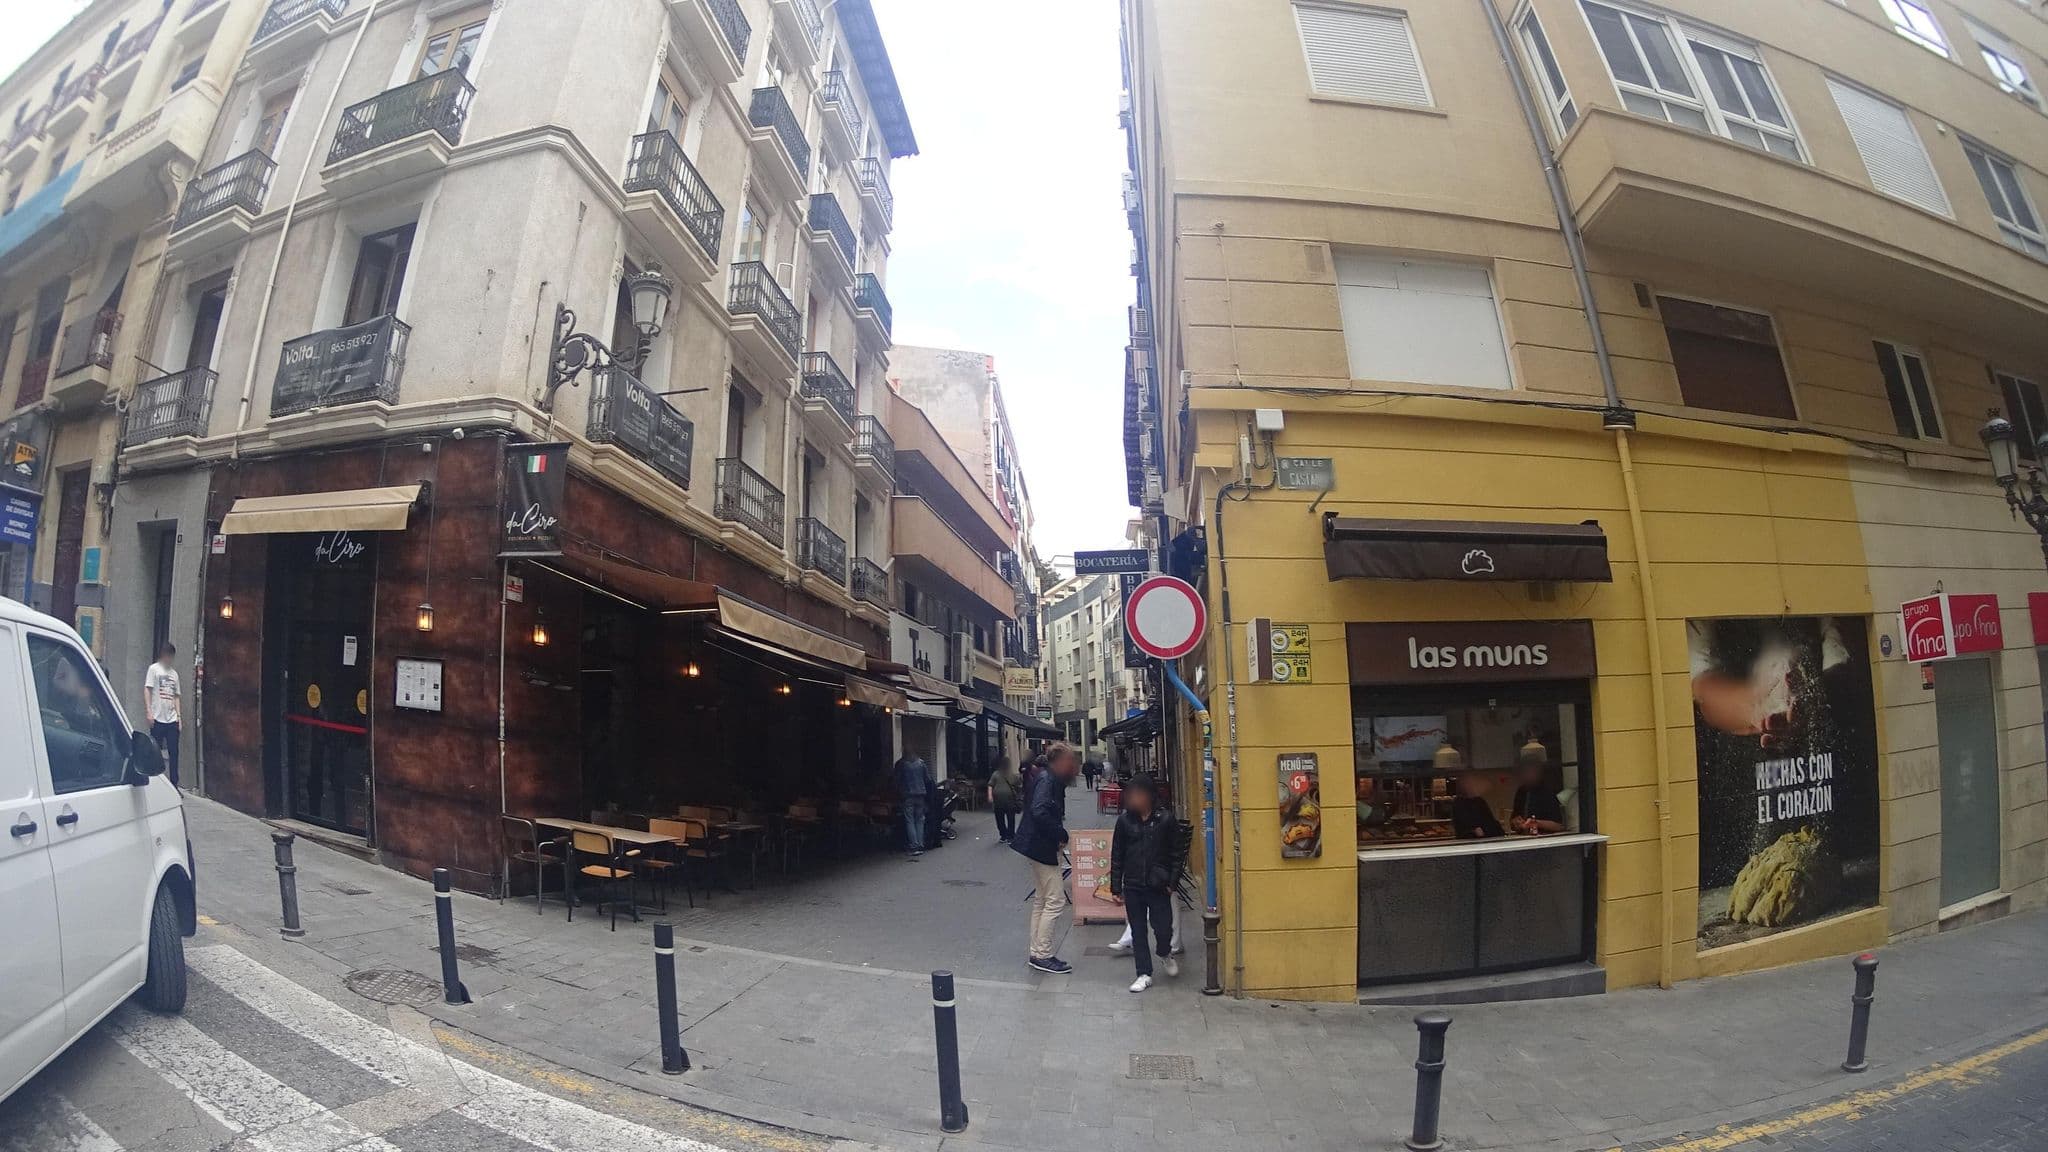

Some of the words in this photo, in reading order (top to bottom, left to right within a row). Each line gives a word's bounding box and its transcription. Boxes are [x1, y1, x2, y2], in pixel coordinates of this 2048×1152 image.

[1076, 554, 1138, 568] BOCATERÍA
[1904, 604, 1930, 619] grupo
[1953, 623, 1972, 643] upo
[1408, 636, 1457, 668] las
[1463, 644, 1548, 667] muns
[1280, 757, 1301, 771] MENÚ
[1808, 753, 1833, 781] CON
[1757, 795, 1774, 824] EL
[1777, 780, 1833, 820] CORAZÓN
